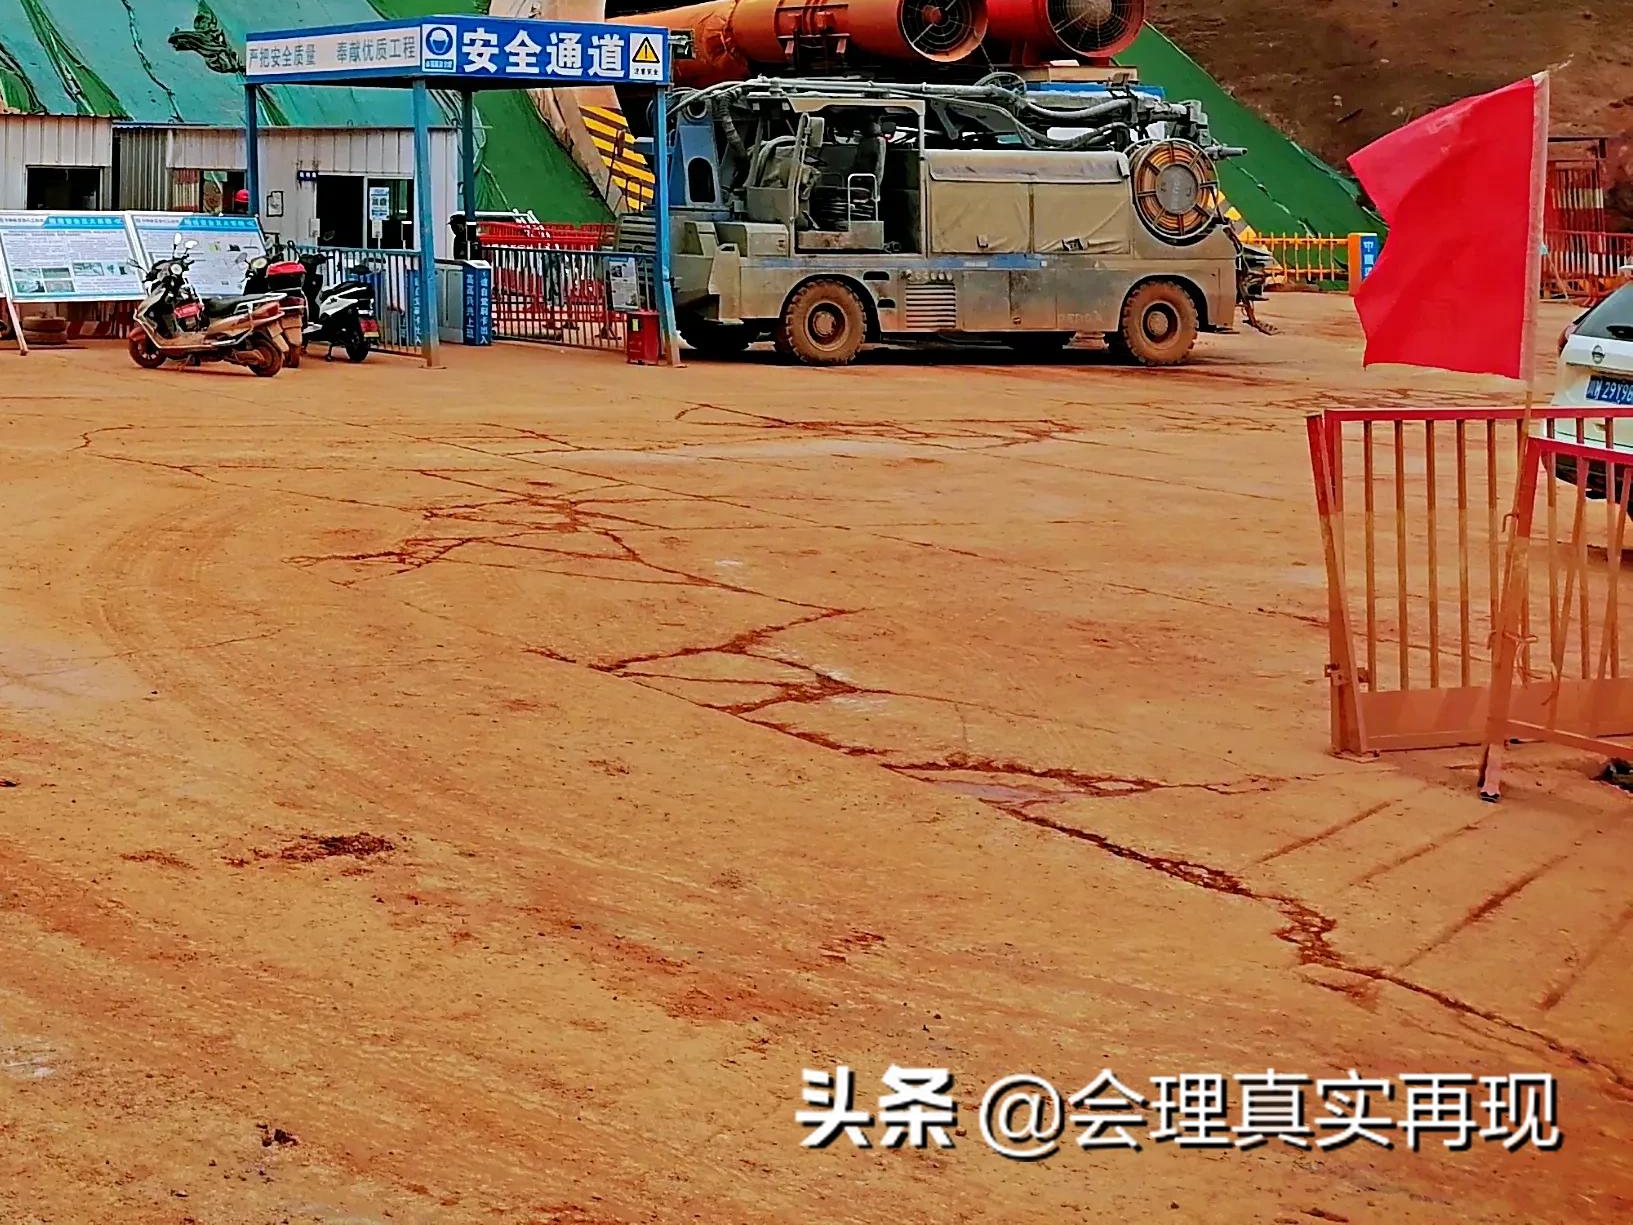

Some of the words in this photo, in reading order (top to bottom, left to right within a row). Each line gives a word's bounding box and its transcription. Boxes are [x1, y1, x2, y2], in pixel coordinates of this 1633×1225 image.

[248, 43, 317, 69] 严把安全质量
[336, 35, 416, 64] 奉献优质工程
[461, 26, 626, 78] 安全通道
